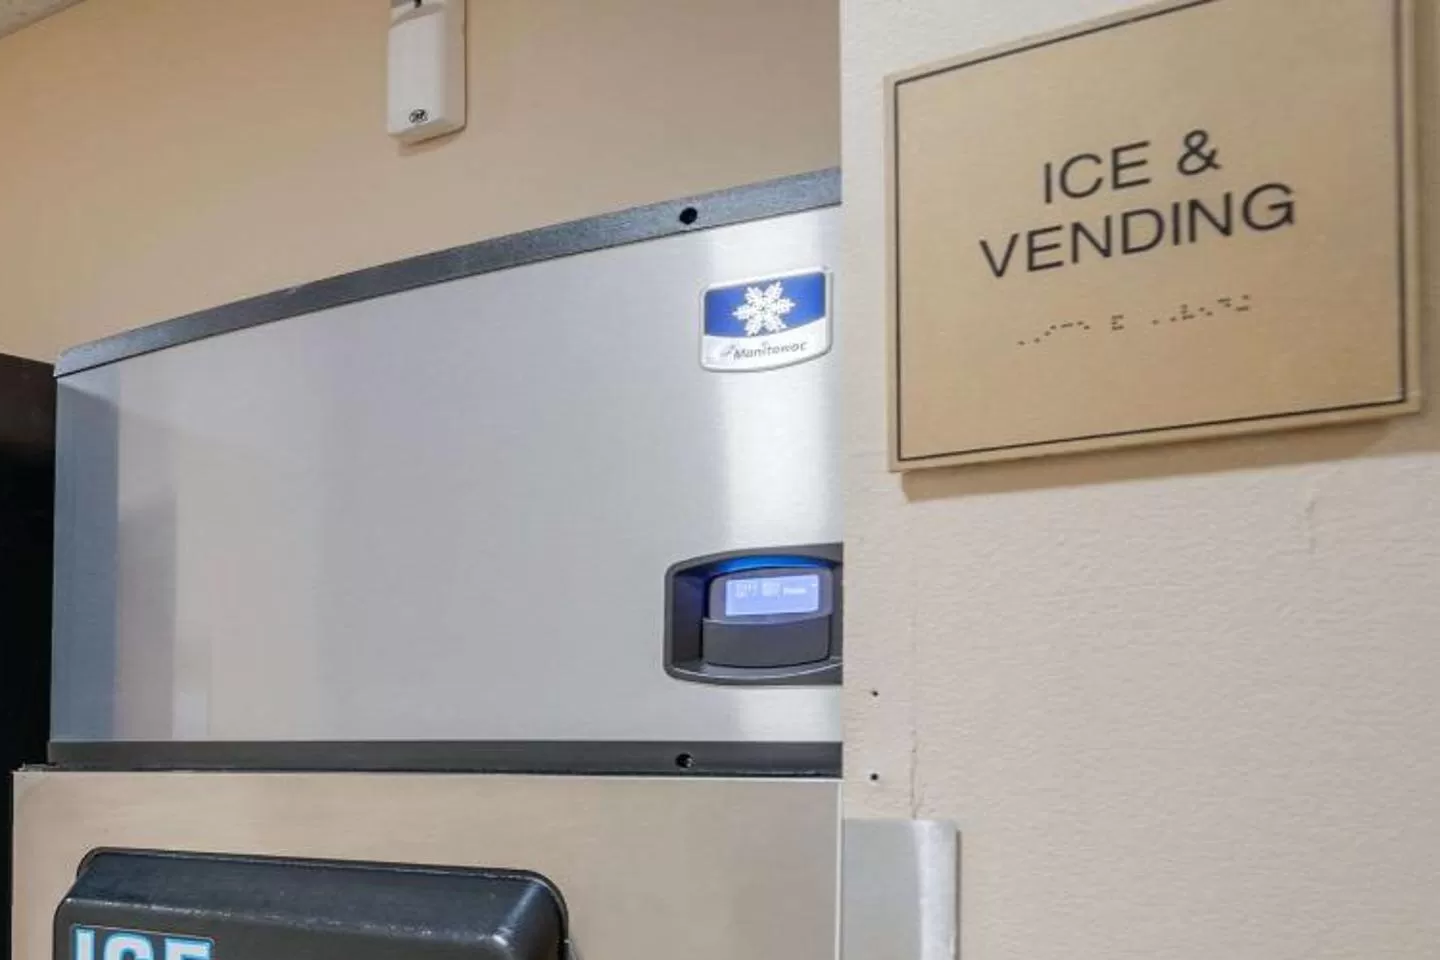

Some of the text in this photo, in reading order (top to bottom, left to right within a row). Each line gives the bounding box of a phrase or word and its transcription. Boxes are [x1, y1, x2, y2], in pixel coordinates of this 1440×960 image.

[1043, 129, 1222, 204] ICE &
[979, 183, 1295, 278] VENDING
